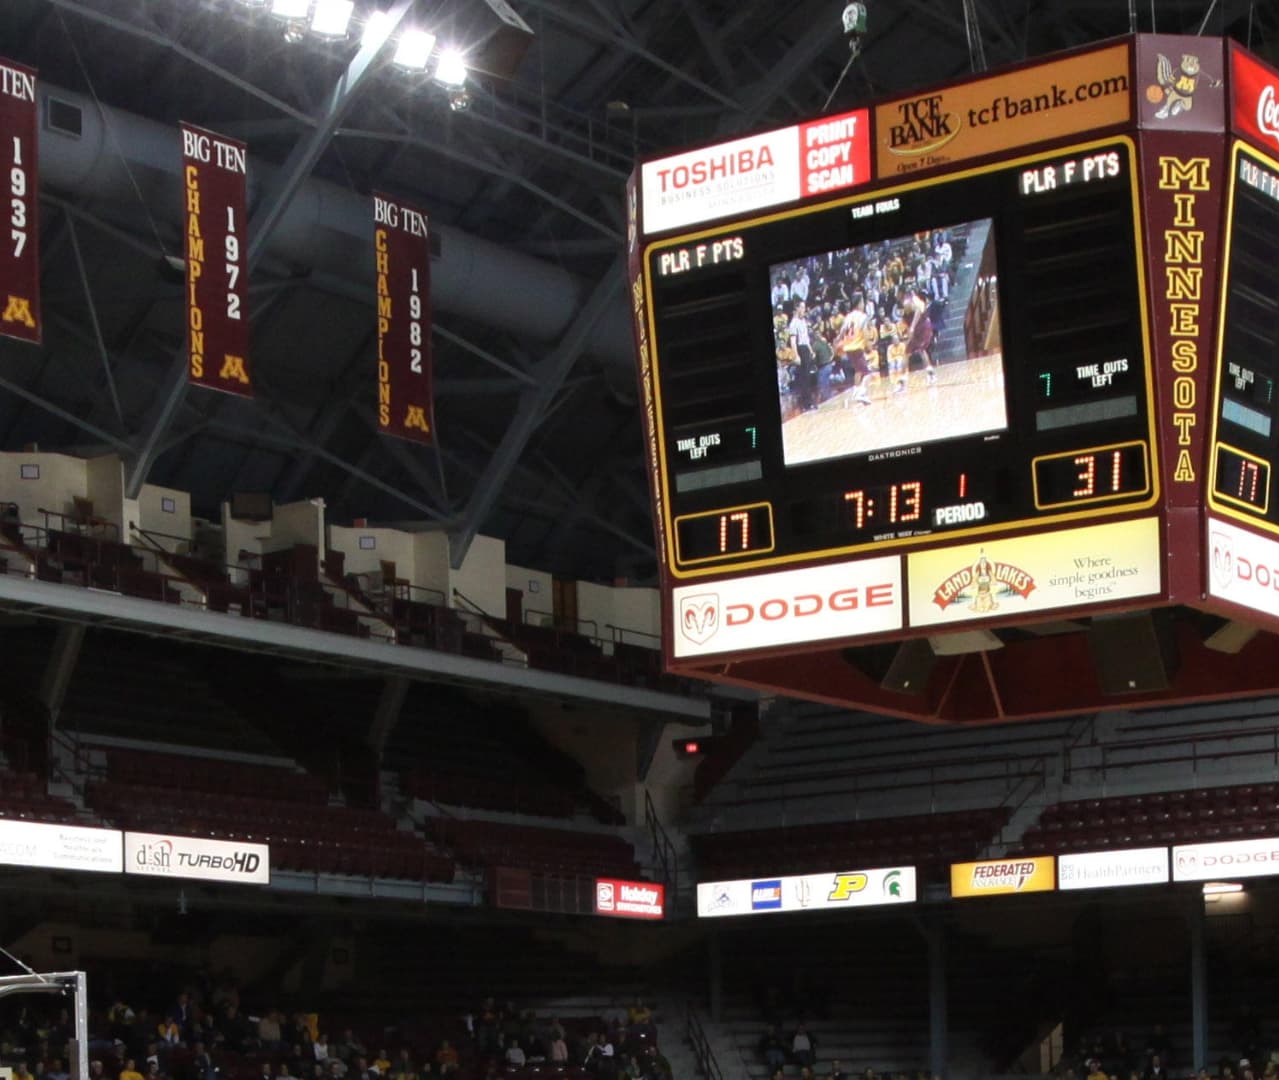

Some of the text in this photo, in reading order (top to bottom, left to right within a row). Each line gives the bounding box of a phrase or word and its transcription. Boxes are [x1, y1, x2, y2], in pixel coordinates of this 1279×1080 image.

[1, 64, 36, 103] TEN
[898, 95, 943, 125] TCF
[806, 116, 857, 148] PRINT
[889, 113, 952, 149] BANK
[182, 128, 246, 175] BIG TEN
[807, 141, 852, 170] COPY
[657, 145, 774, 192] TOSHIBA
[807, 164, 854, 193] SCAN
[1023, 153, 1119, 194] PLR F PTS
[10, 137, 27, 257] 1937
[852, 199, 900, 219] TEAM FOULS
[374, 197, 428, 239] BIG TEN
[185, 166, 204, 378] CHAMPIONS
[225, 206, 241, 320] 1972
[661, 238, 744, 276] PLR F PTS
[375, 229, 392, 426] CHAMPIONS
[409, 268, 422, 374] 1982
[1159, 156, 1210, 482] MINNESOTA
[1039, 373, 1051, 396] 7
[1077, 359, 1128, 379] TIME OUTS
[1092, 374, 1112, 387] LEFT
[677, 433, 721, 451] TIME OUTS
[690, 447, 708, 460] LEFT
[745, 427, 757, 448] 7
[868, 447, 922, 461] DAKTRONICS
[959, 473, 965, 498] 1
[1073, 451, 1121, 497] 31
[1237, 459, 1259, 501] 17
[844, 482, 921, 528] 7:13
[935, 502, 986, 525] PERIOD
[719, 512, 749, 552] 17
[1049, 566, 1140, 590] simple goodness
[1073, 556, 1113, 570] Where
[938, 566, 1033, 600] LAND LAKES
[726, 583, 894, 627] DODGE
[178, 853, 232, 870] TURBO
[974, 862, 1035, 878] FEDERATED
[1077, 865, 1163, 882] HealthPartners
[620, 885, 658, 905] Holiday
